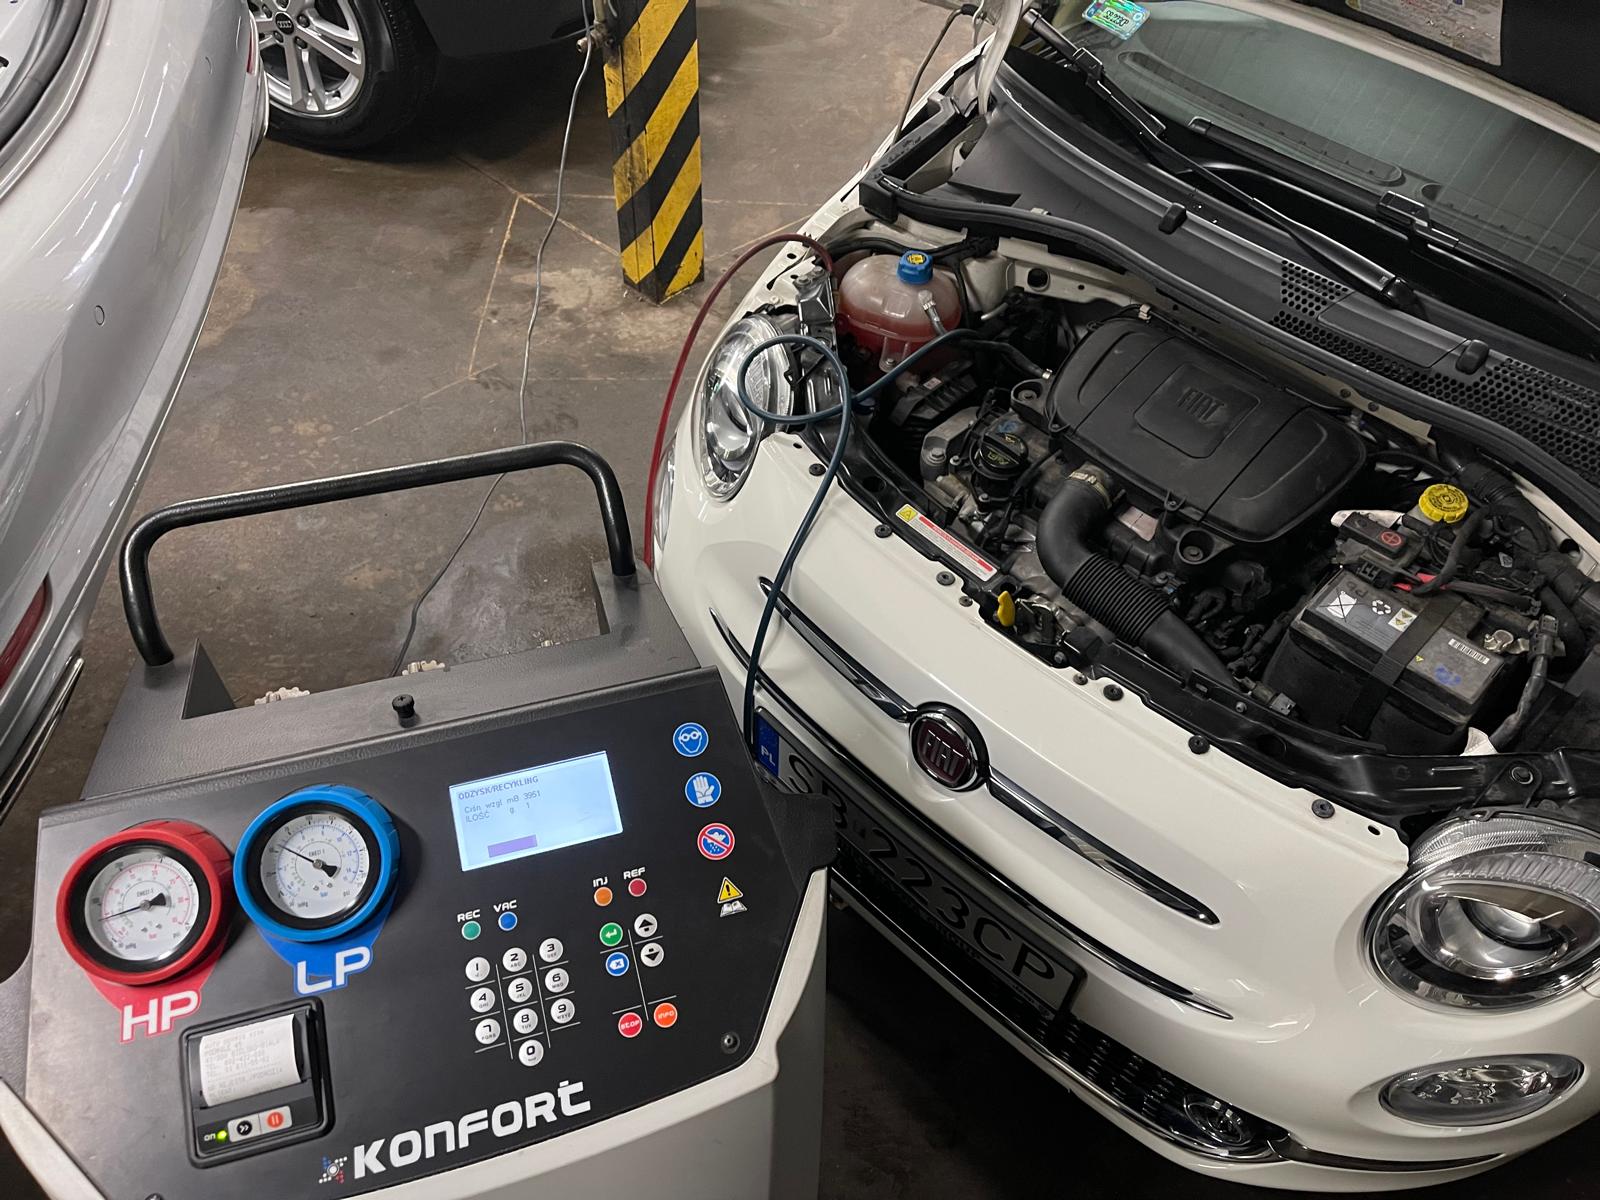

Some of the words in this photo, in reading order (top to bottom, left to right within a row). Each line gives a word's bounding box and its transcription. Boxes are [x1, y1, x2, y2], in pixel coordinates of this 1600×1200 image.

[760, 744, 776, 767] PL
[922, 729, 965, 777] FIAT
[458, 776, 539, 800] ODZYSK/RECYKLING
[623, 867, 646, 880] REF
[592, 876, 609, 888] INJ
[493, 899, 518, 913] VAC
[868, 828, 1056, 980] 223CP
[457, 909, 481, 923] REC
[546, 943, 555, 953] 3
[510, 953, 519, 962] 2
[297, 946, 371, 994] LP
[552, 973, 561, 983] 6
[515, 983, 524, 993] 5
[478, 993, 487, 1001] 4
[557, 1003, 567, 1014] 9
[123, 990, 199, 1041] HP
[521, 1014, 530, 1023] 8
[658, 1010, 675, 1020] INFO
[483, 1024, 492, 1033] 7
[620, 1020, 640, 1030] STOP
[526, 1046, 536, 1056] 0
